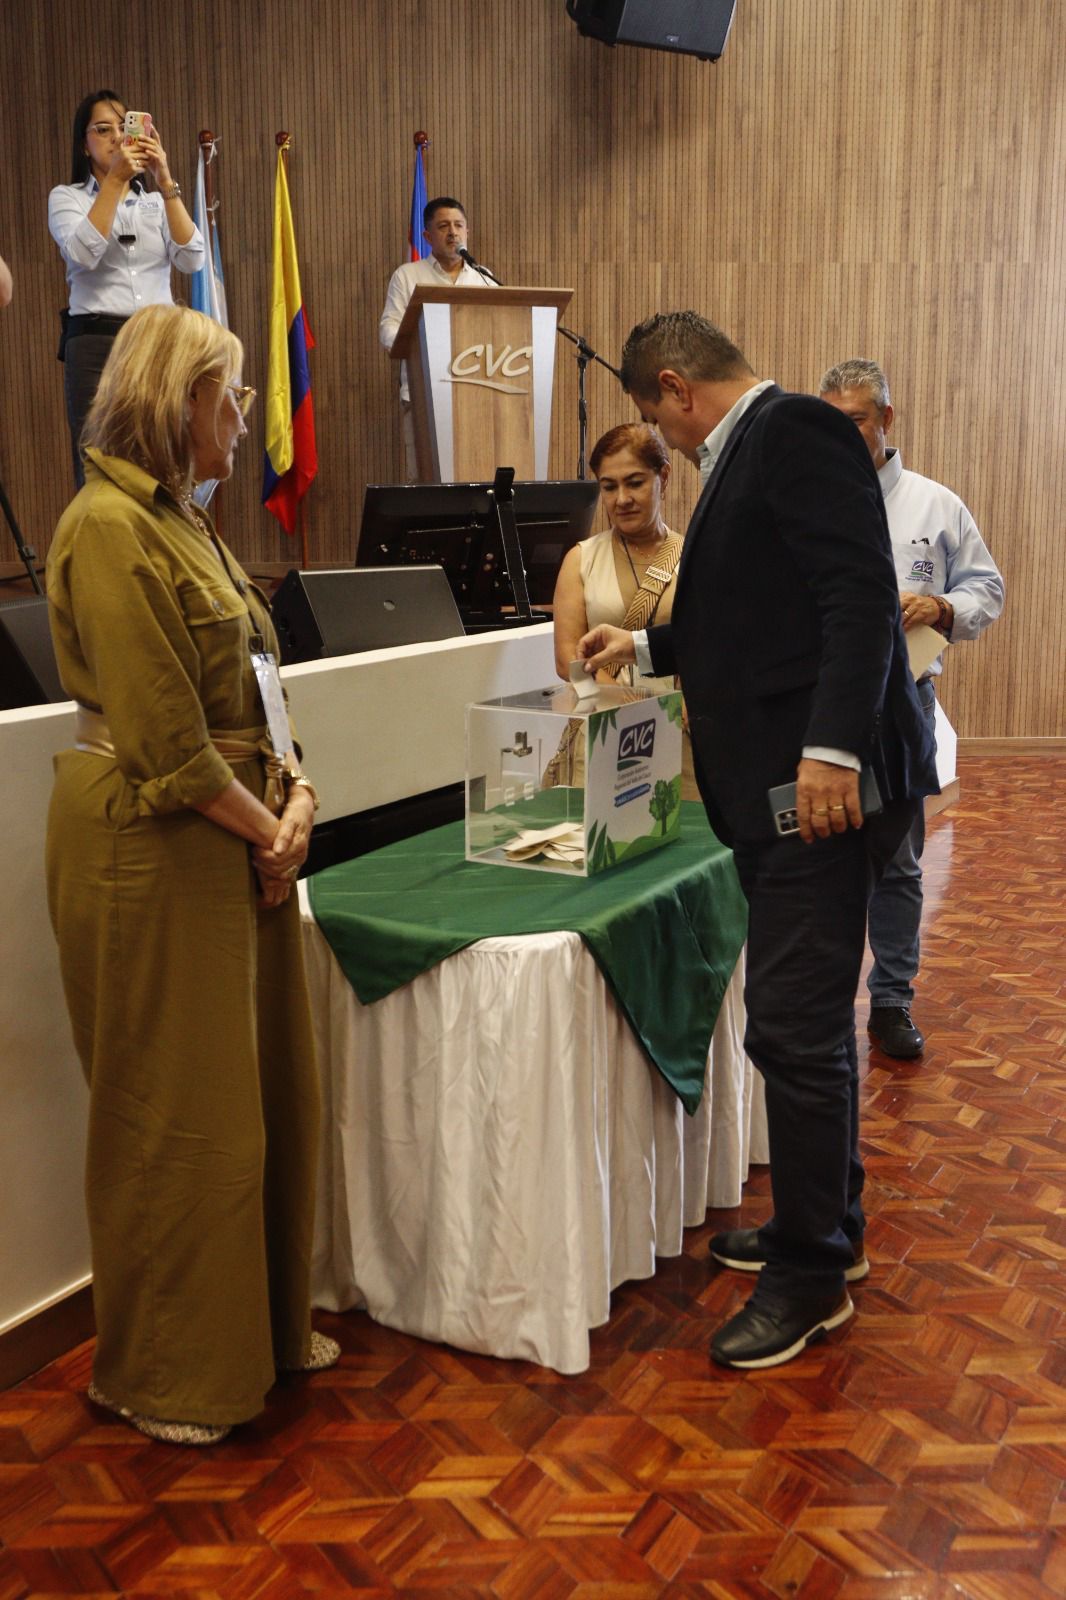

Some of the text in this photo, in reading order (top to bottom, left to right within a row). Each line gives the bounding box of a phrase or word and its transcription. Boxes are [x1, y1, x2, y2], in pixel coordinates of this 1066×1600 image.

[452, 343, 533, 377] CVC
[913, 562, 933, 572] CVC
[620, 722, 654, 757] CVC
